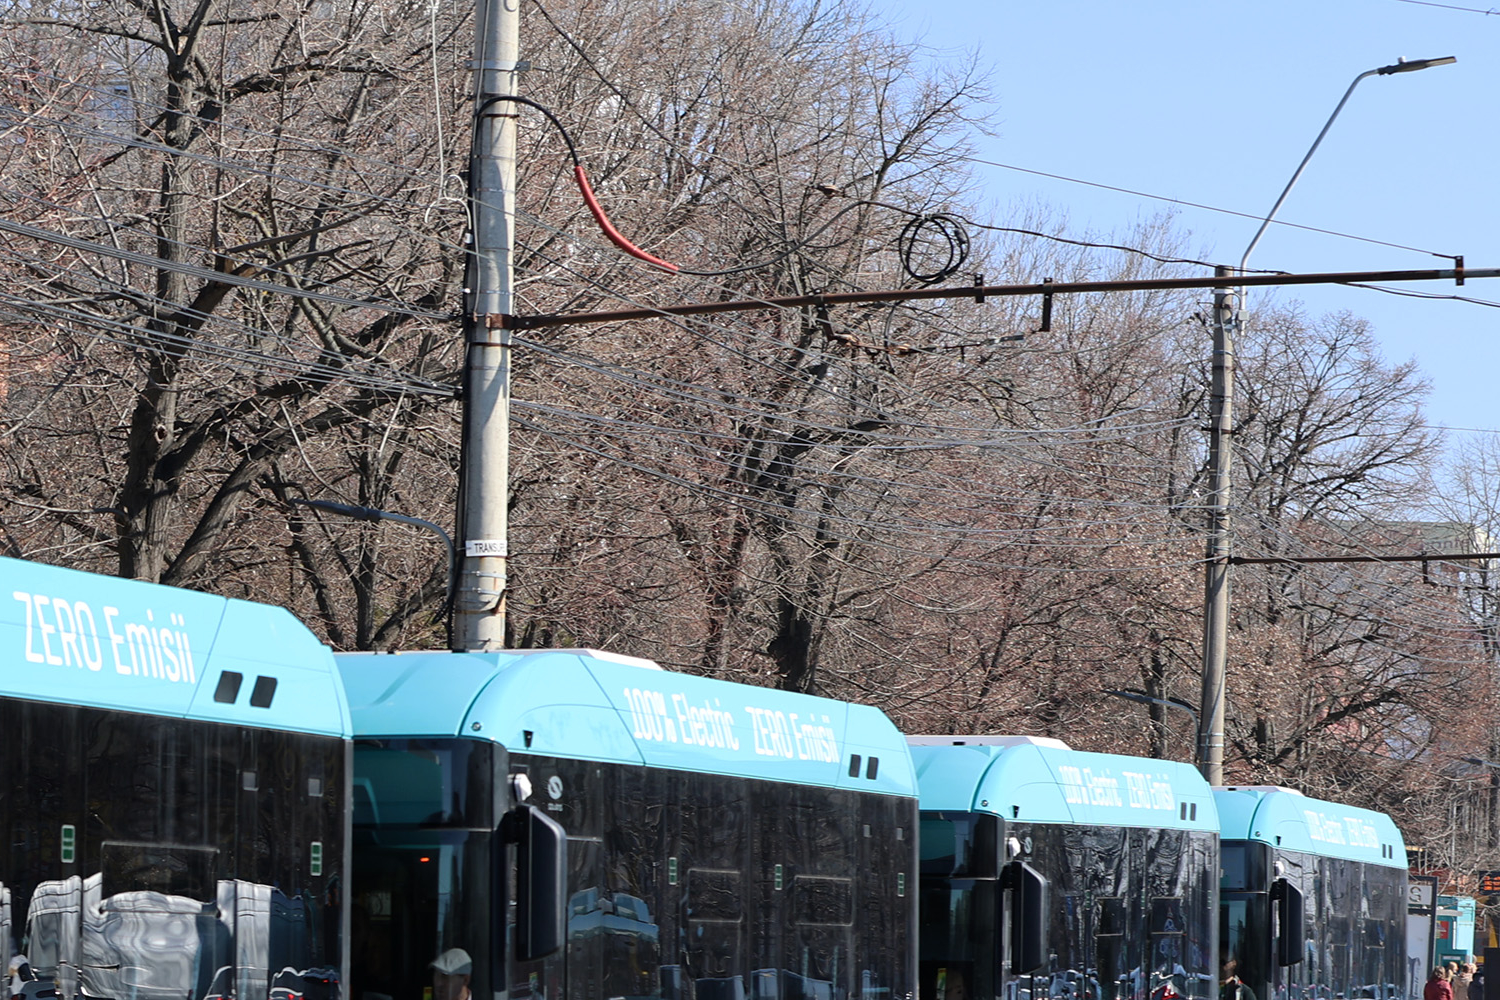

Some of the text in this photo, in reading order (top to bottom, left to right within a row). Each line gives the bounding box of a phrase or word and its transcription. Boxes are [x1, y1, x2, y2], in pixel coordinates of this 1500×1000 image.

[13, 591, 102, 672] ZERO
[103, 606, 196, 684] Emisii
[623, 687, 677, 744] 100%
[671, 692, 740, 751] Electric
[745, 706, 794, 759] ZERO
